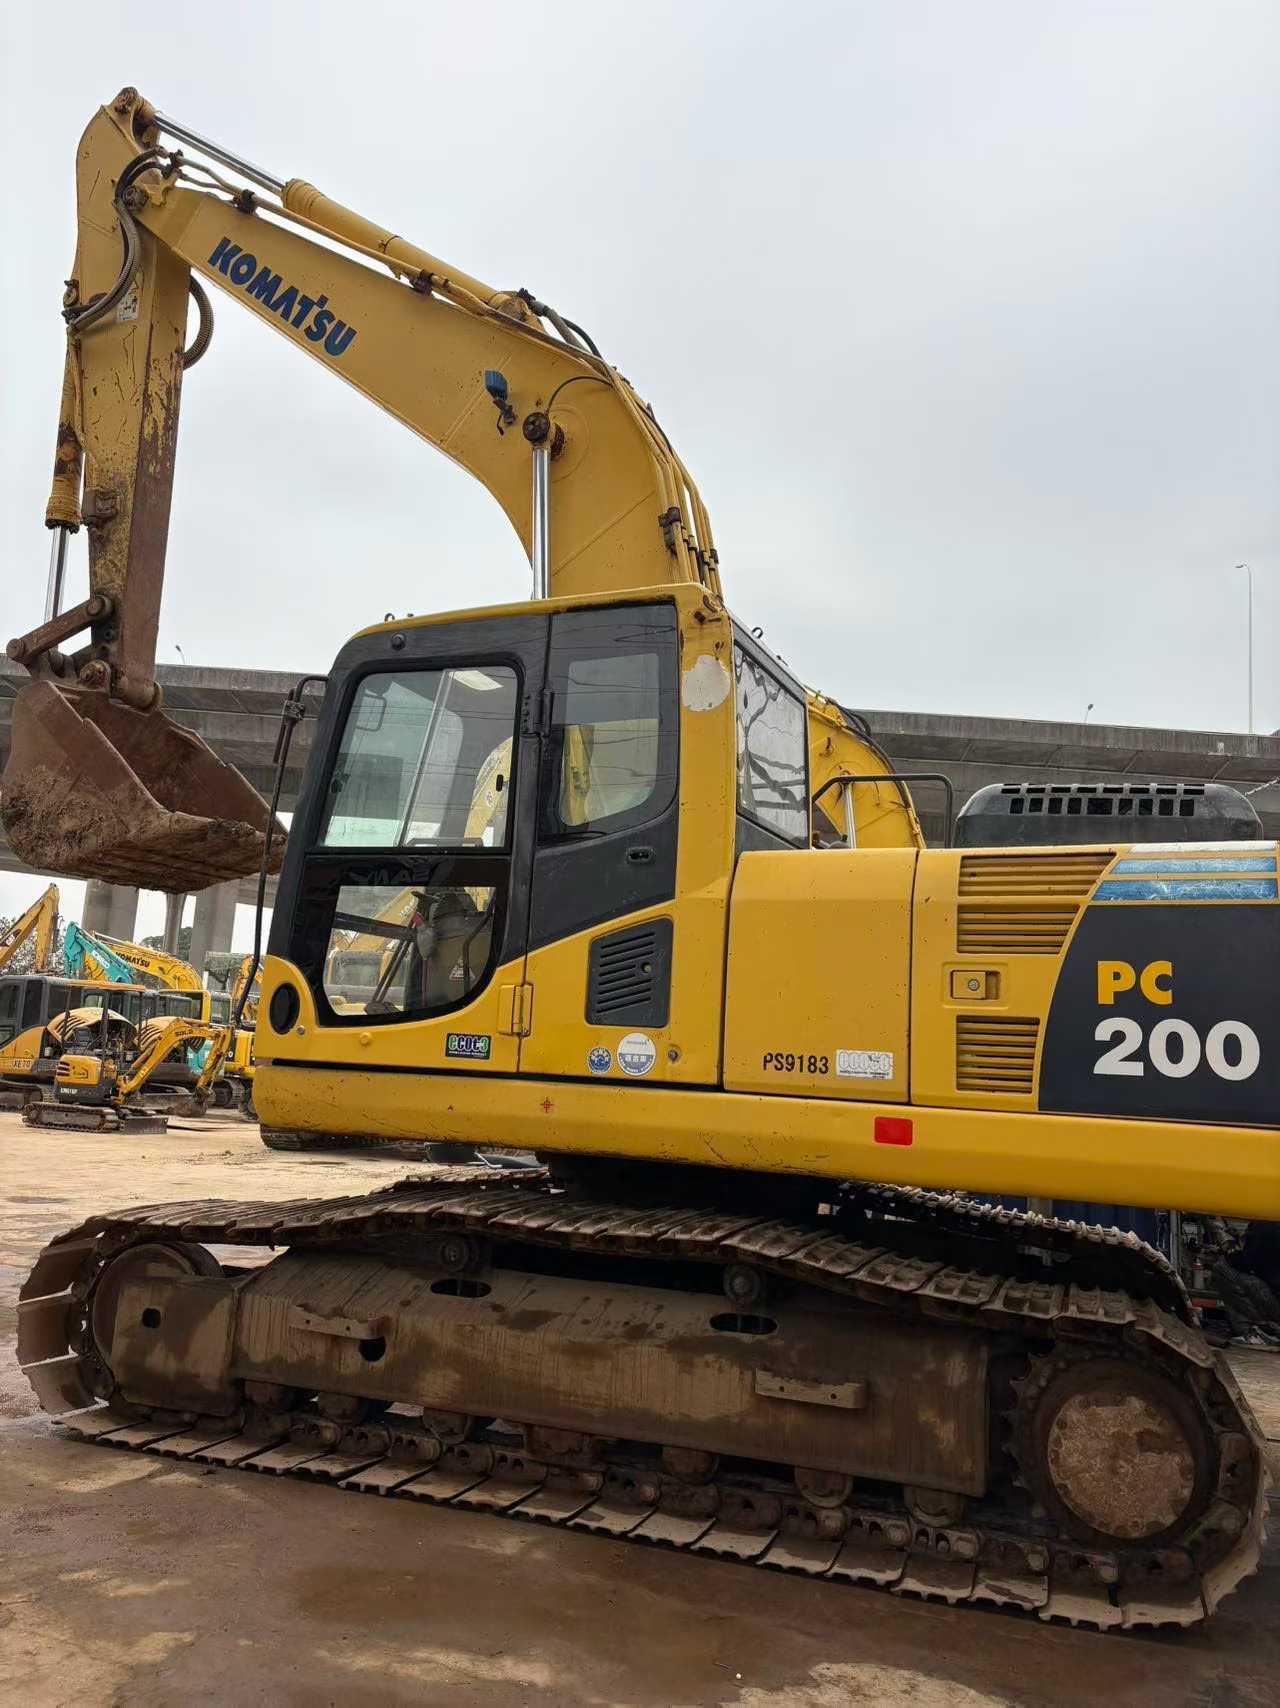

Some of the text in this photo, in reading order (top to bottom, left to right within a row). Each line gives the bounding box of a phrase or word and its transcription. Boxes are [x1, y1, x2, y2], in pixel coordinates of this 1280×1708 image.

[207, 236, 358, 357] KOMATSU
[1097, 960, 1173, 1005] PC
[763, 1052, 829, 1074] PS9183
[1093, 1017, 1260, 1081] 200
